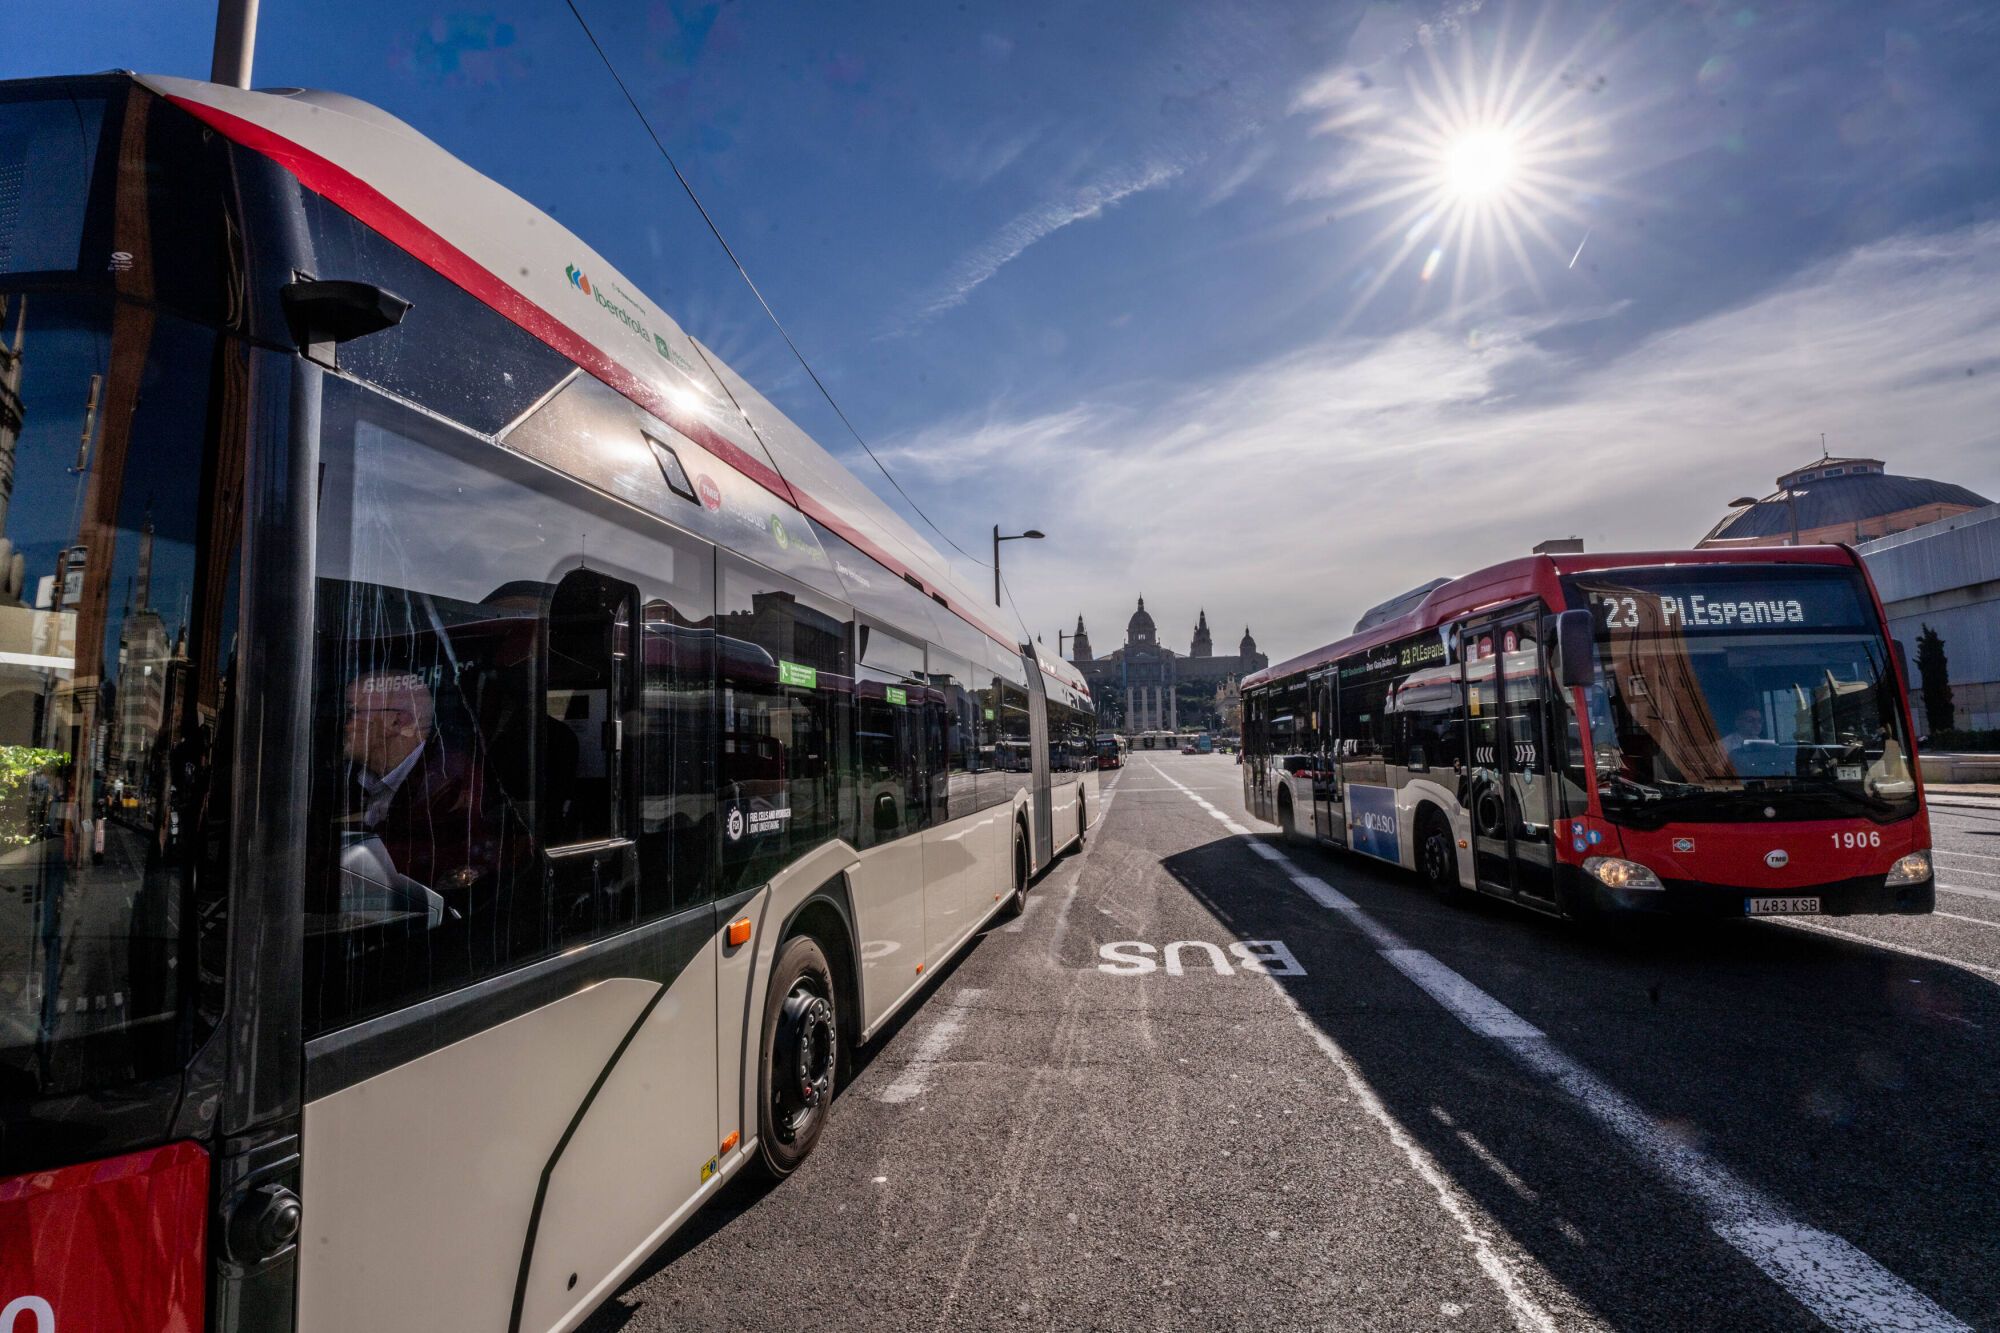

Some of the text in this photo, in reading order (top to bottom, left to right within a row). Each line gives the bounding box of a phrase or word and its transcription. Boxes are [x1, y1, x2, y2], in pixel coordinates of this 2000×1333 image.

[592, 285, 650, 343] Iberdrola
[1603, 595, 1804, 628] 23 Pl.Espanya
[1401, 648, 1411, 666] 23
[1364, 811, 1395, 834] OCASO
[1831, 831, 1881, 849] 1906
[1755, 899, 1818, 913] 1483 KSB
[1098, 940, 1309, 976] BUS
